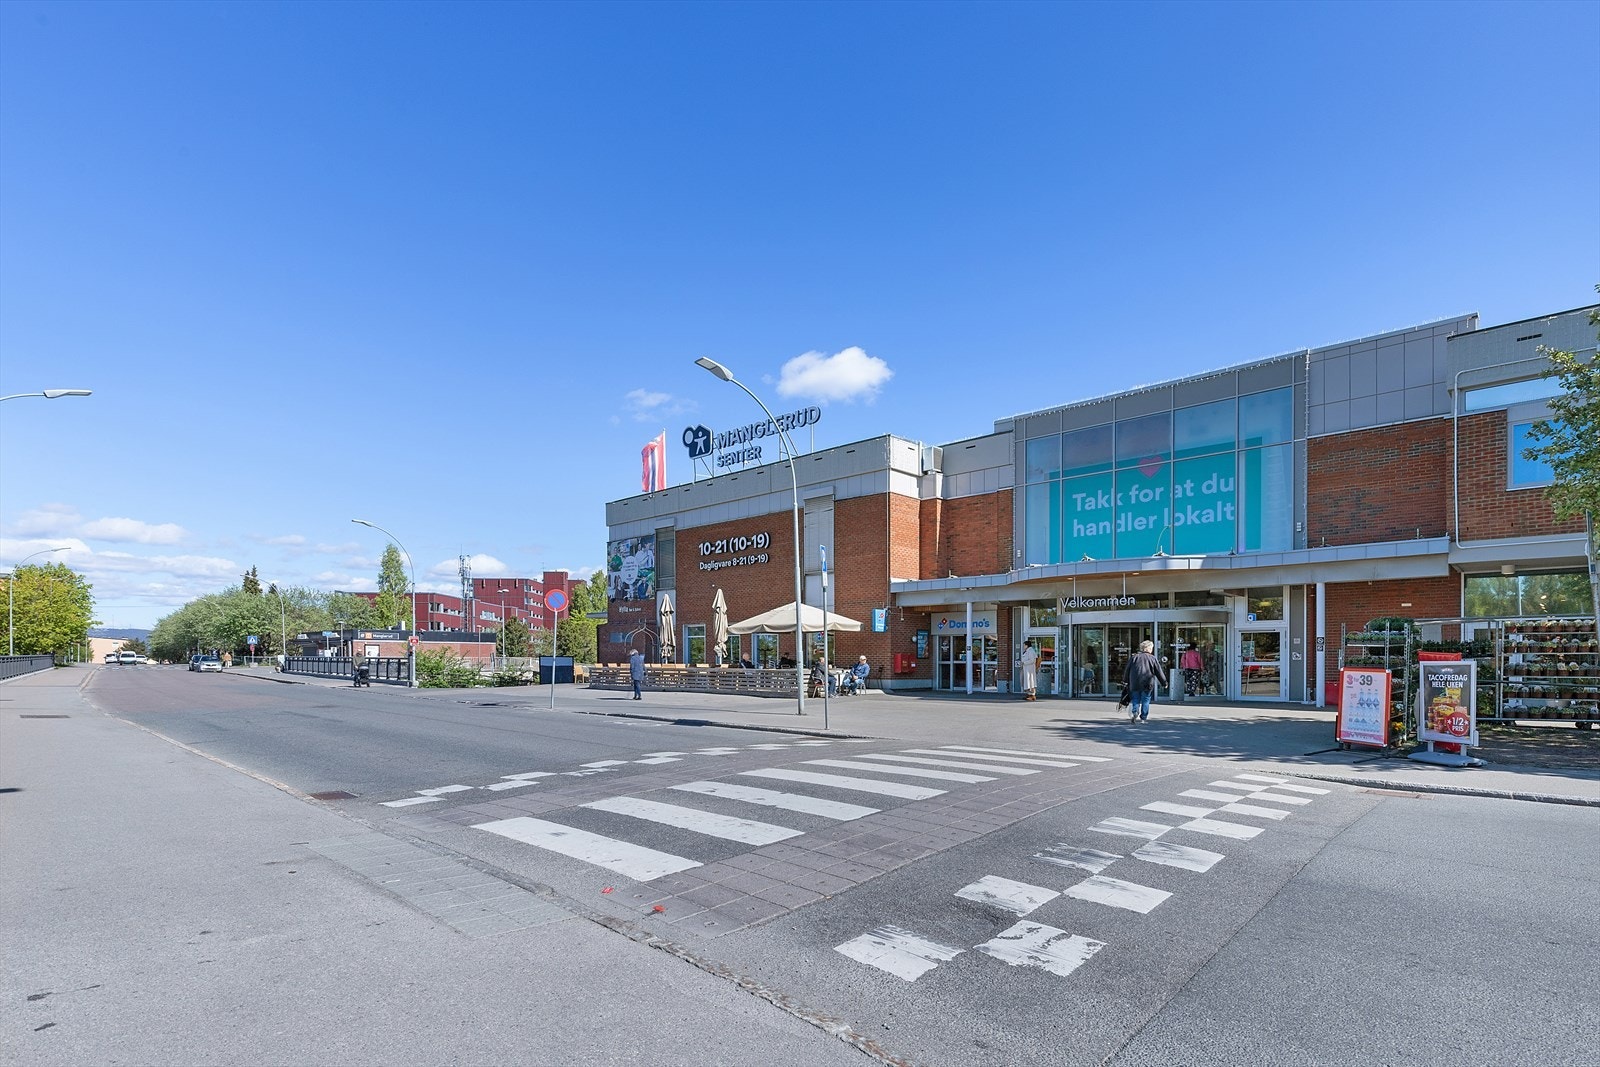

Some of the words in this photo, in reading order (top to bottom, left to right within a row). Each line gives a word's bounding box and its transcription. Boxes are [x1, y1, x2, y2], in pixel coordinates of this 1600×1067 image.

[717, 406, 821, 449] MANGLERUD
[717, 446, 762, 467] SENTER
[1072, 487, 1124, 512] Takk
[1129, 484, 1164, 504] for
[1170, 479, 1195, 499] at
[1201, 472, 1235, 496] du
[1073, 512, 1158, 538] handler
[1163, 501, 1235, 527] lokalt
[698, 539, 728, 556] 10-21
[729, 532, 770, 553] (10-19)
[699, 559, 732, 571] Dagligvare
[732, 556, 747, 567] 8-21
[747, 553, 769, 565] (9-19)
[1060, 596, 1136, 609] Velkommen
[949, 618, 990, 629] Domno's
[1452, 717, 1464, 726] 1/2
